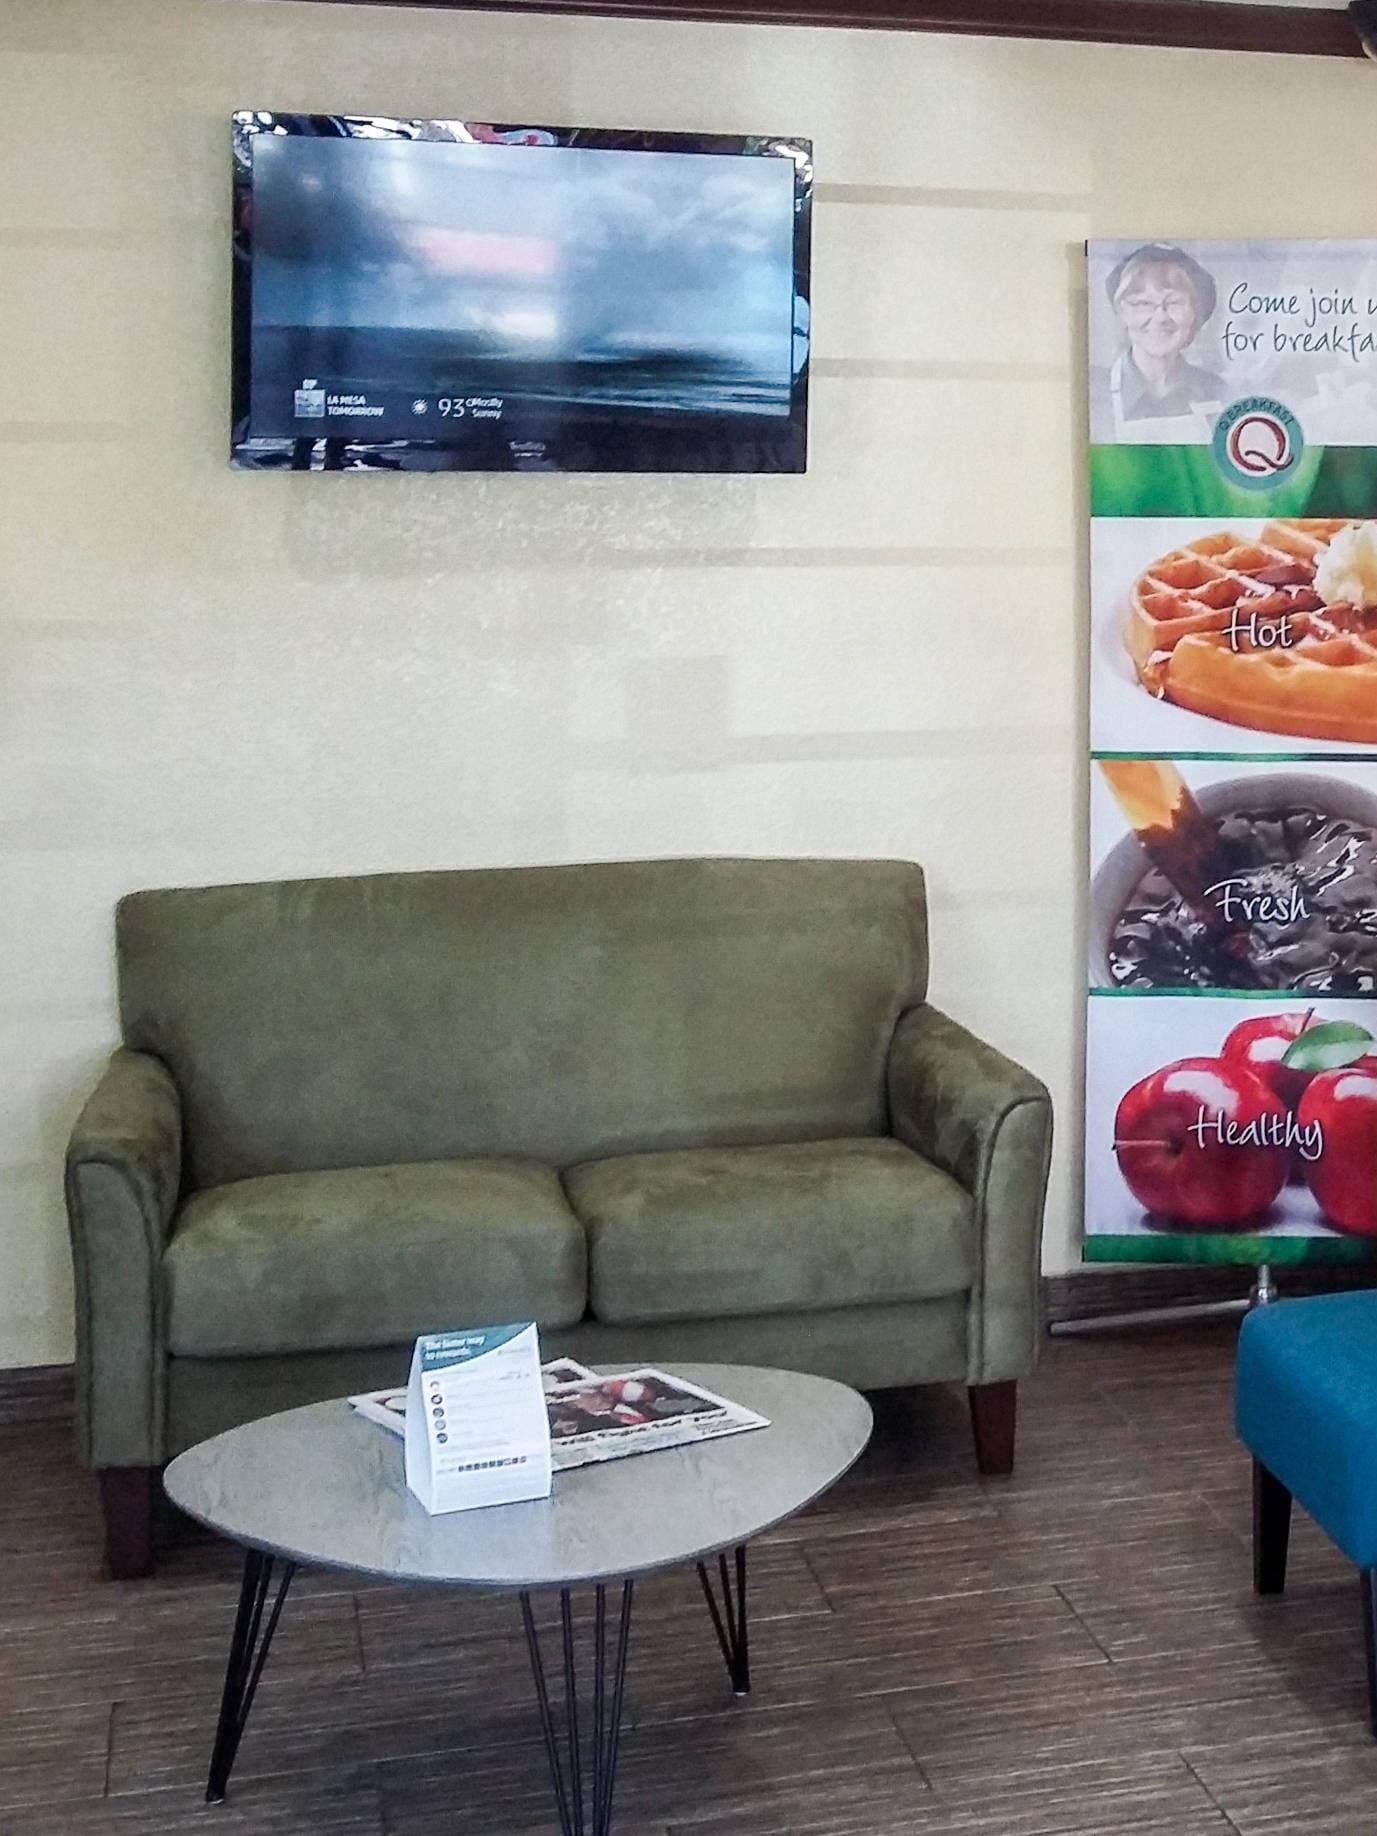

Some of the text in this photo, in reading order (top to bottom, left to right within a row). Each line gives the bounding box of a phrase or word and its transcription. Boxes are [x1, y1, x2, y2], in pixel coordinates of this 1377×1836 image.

[1228, 282, 1301, 314] Come
[1304, 287, 1358, 328] join
[1222, 321, 1265, 361] for
[326, 395, 339, 405] LA
[327, 406, 385, 417] TOMORROW
[1230, 416, 1295, 472] Q
[1221, 607, 1293, 652] Hot
[1203, 878, 1311, 923] Fresh
[1187, 1104, 1323, 1161] Healthy
